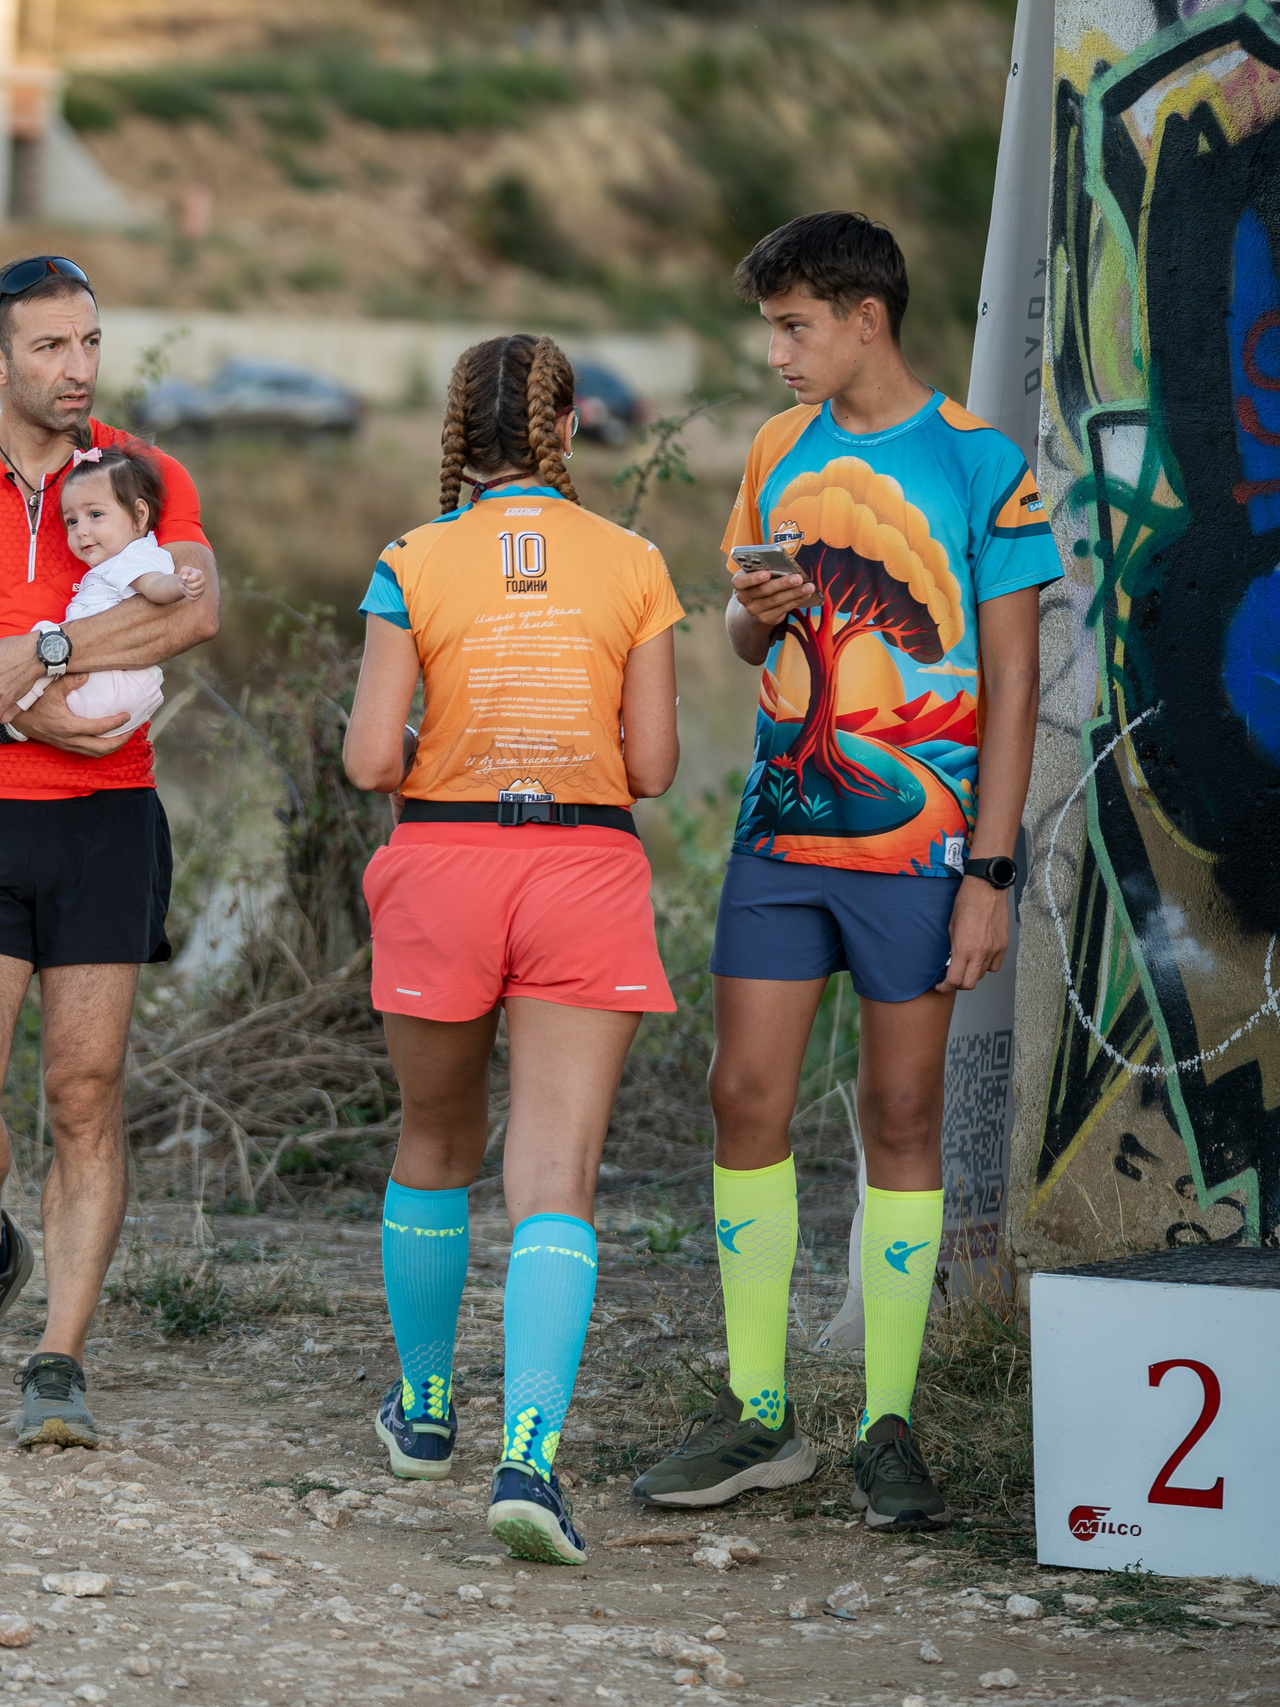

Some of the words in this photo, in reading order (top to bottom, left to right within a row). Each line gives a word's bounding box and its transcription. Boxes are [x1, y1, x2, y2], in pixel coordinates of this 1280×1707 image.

[497, 531, 547, 579] 10
[506, 580, 548, 593] ГОДИНИ
[384, 1218, 409, 1233] TRY
[413, 1227, 437, 1237] TO
[439, 1226, 465, 1237] FLY
[513, 1245, 541, 1259] TRY
[546, 1245, 572, 1255] TO
[1148, 1358, 1224, 1510] 2
[1071, 1520, 1142, 1537] MILCO
